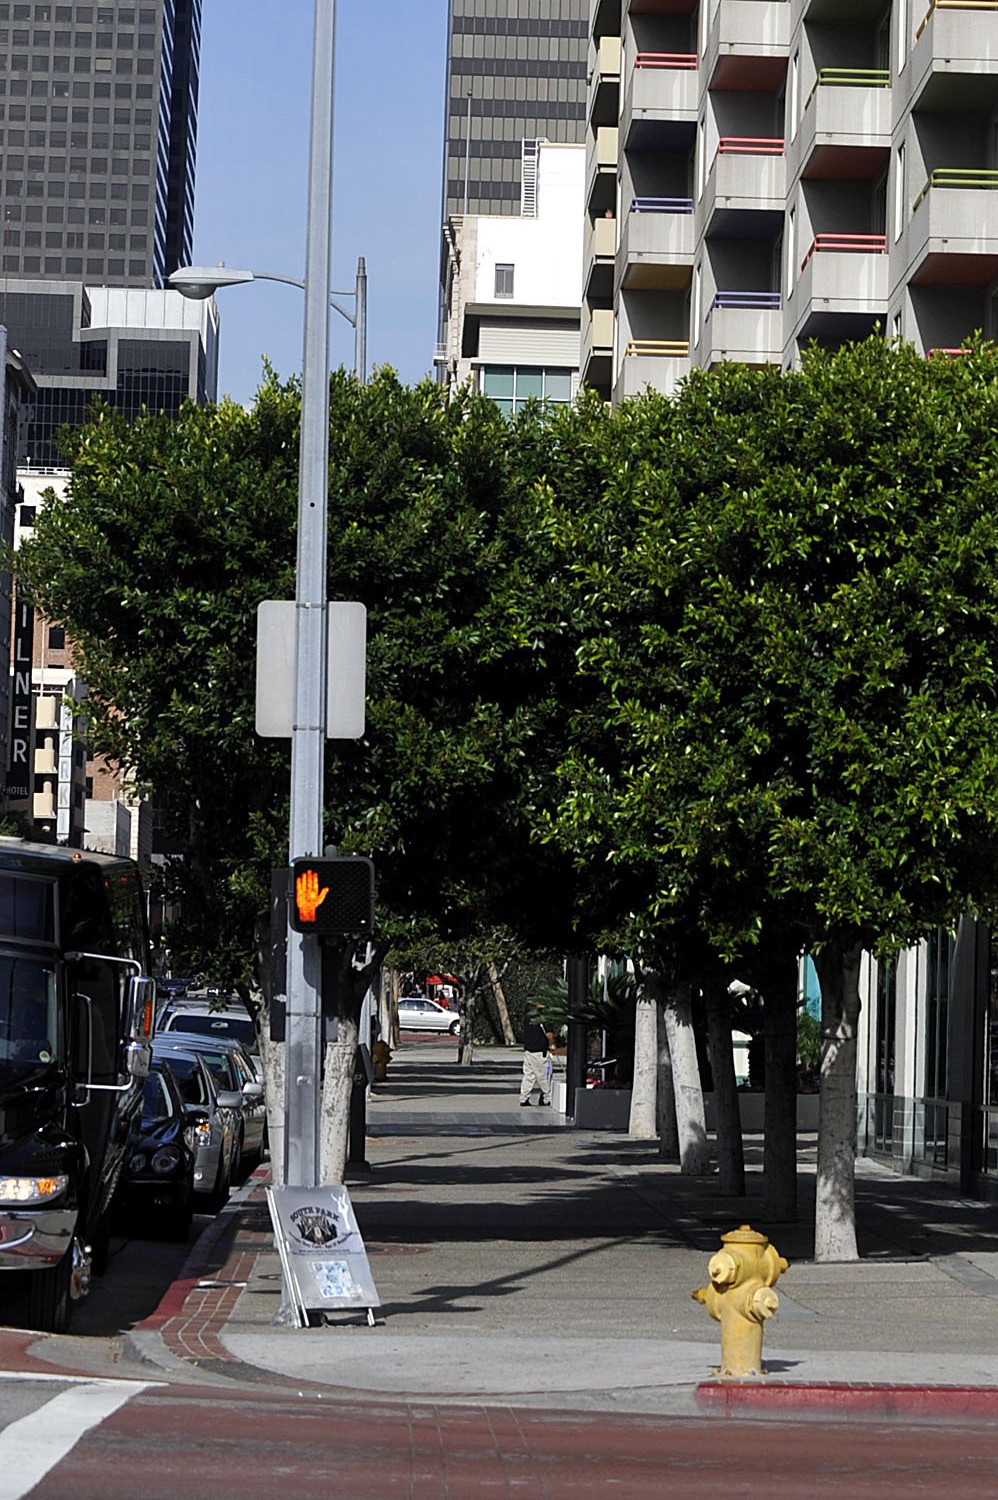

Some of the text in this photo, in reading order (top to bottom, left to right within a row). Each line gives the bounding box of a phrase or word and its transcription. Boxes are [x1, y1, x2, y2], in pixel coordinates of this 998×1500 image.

[13, 583, 30, 762] ILNER
[6, 786, 28, 796] HOTEL
[290, 1206, 340, 1222] SOUTH PARK
